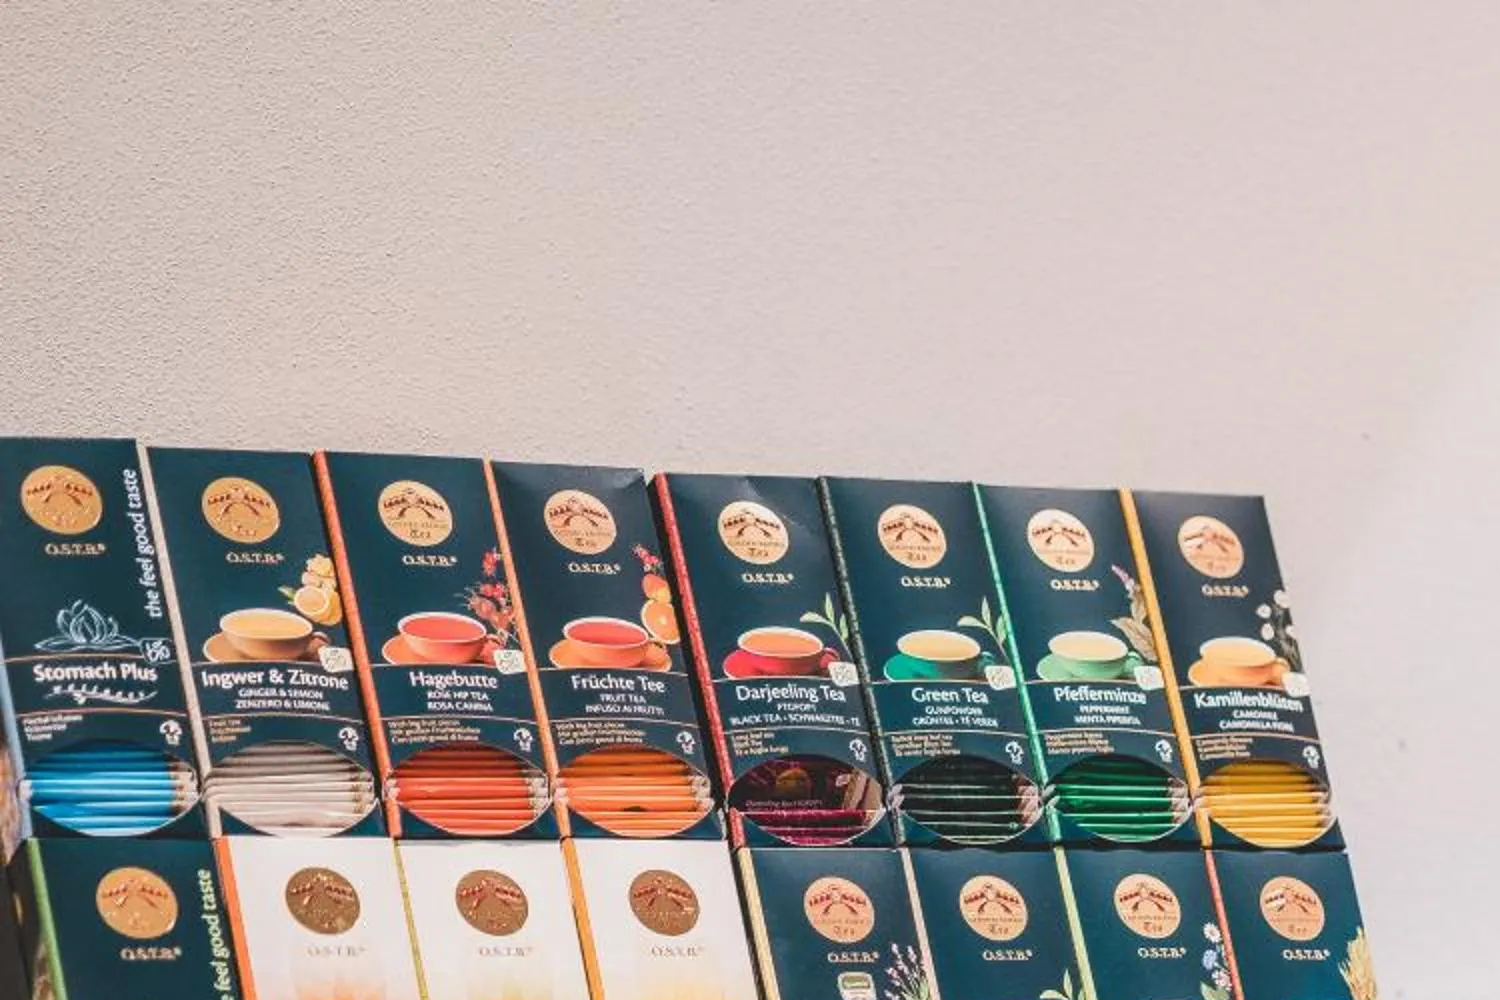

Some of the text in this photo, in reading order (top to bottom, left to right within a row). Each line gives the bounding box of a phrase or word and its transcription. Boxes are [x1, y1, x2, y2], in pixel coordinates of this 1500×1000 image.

[123, 469, 142, 509] taste
[127, 512, 154, 554] good
[136, 558, 156, 588] feel
[144, 590, 162, 617] the
[33, 662, 158, 682] Stomach Plus
[201, 669, 349, 691] Ingwer & Zitrone
[410, 670, 498, 689] Hagebutte
[571, 674, 665, 692] Früchte Tee
[736, 684, 846, 702] Darjeeling Tea
[912, 688, 989, 704] Green Tea
[1054, 686, 1147, 704] Pfefferminze
[1194, 692, 1304, 712] Kamillenblüten
[730, 716, 762, 726] BLACK
[764, 714, 782, 722] TEA
[198, 869, 217, 910] taste
[201, 914, 230, 958] good
[209, 961, 231, 991] feel
